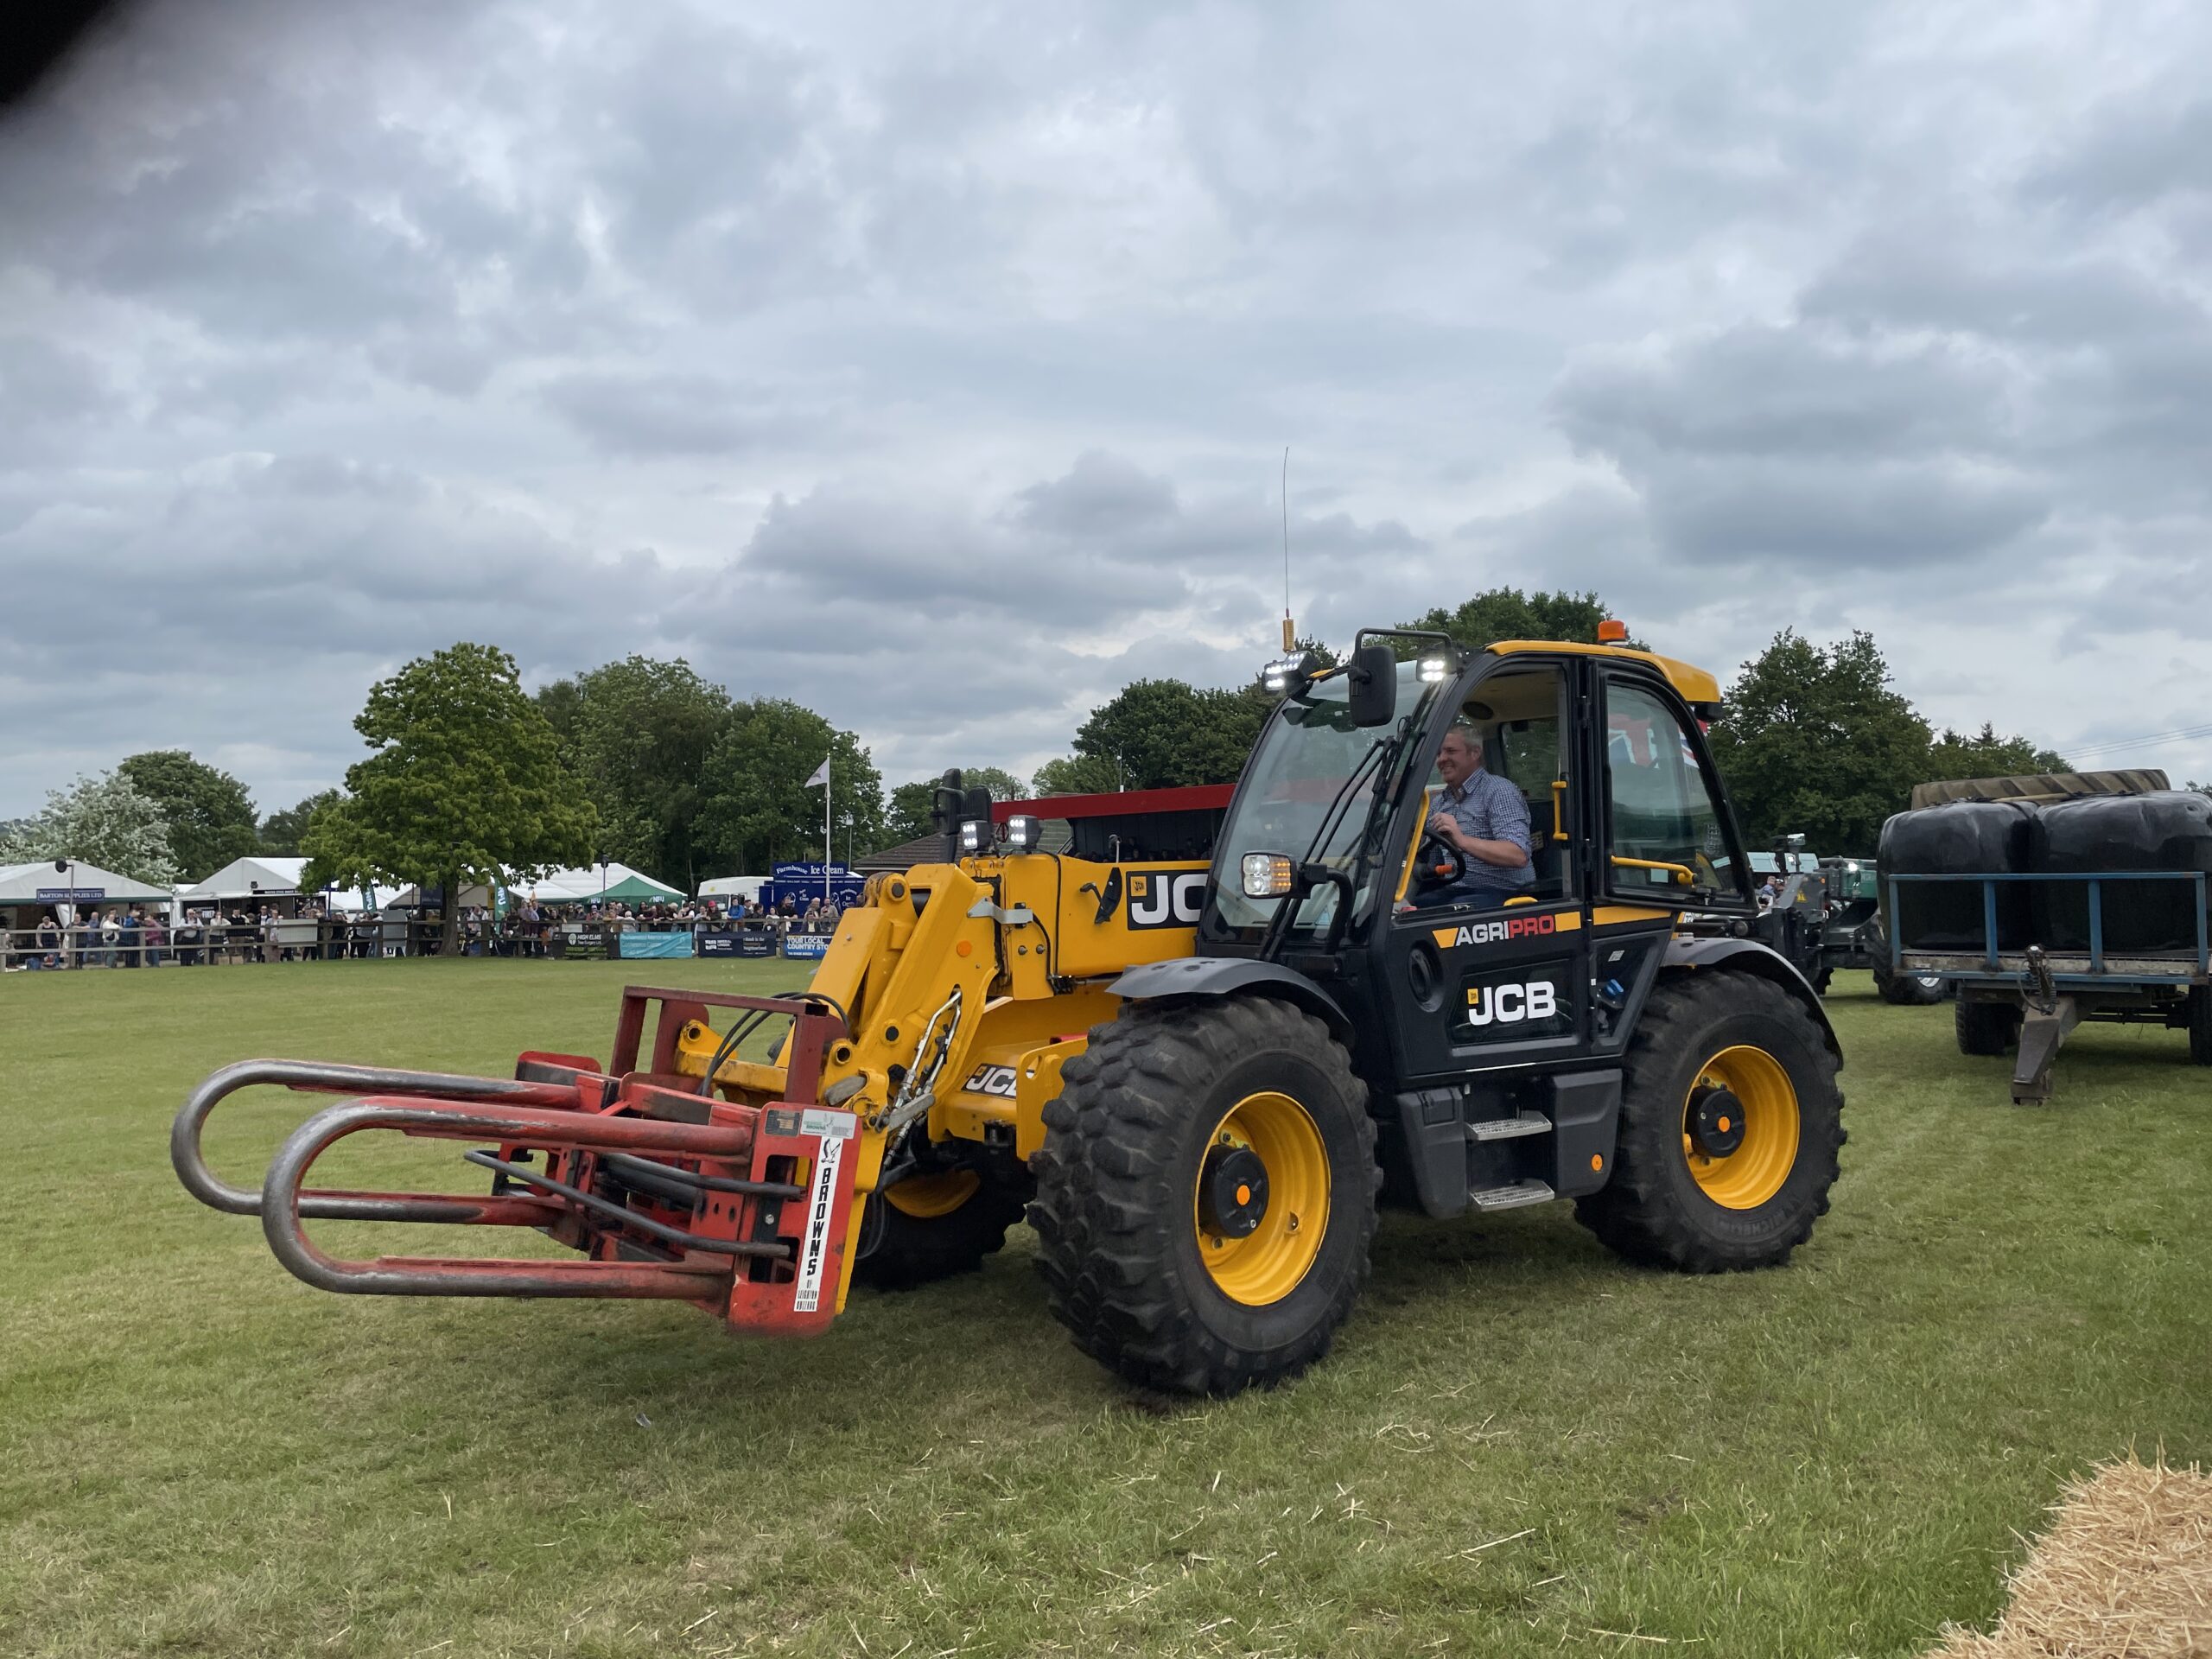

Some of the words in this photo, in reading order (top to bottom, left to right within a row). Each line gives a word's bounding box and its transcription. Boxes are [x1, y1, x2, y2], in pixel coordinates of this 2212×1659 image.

[776, 865, 808, 874] Farmhouse
[810, 865, 821, 874] Ice
[822, 865, 844, 874] Cream
[1131, 874, 1209, 925] JC
[1455, 915, 1554, 946] AGRIPRO
[1469, 981, 1556, 1026] JCB
[966, 1066, 1017, 1096] JC
[806, 1167, 831, 1276] BROWNS
